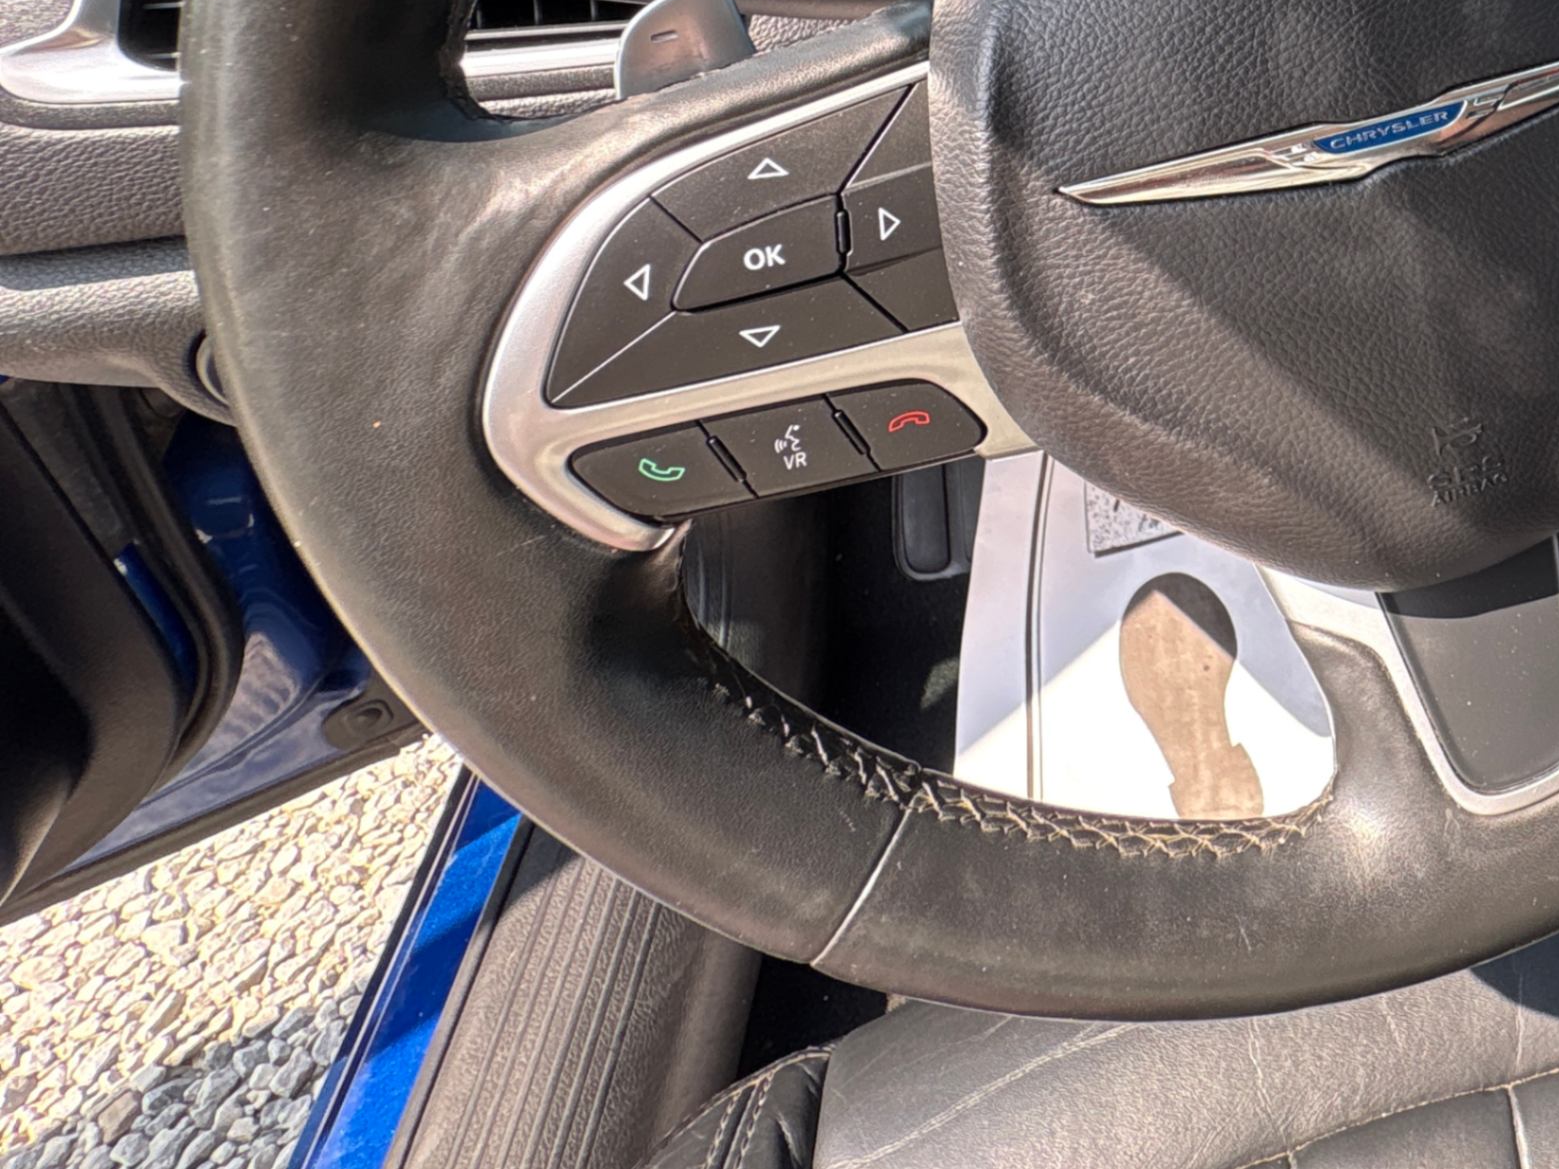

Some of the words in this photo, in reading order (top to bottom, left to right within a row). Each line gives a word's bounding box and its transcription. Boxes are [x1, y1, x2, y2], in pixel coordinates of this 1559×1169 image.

[1330, 110, 1449, 149] CHRYSLER
[743, 244, 785, 271] OK
[783, 451, 808, 470] VR
